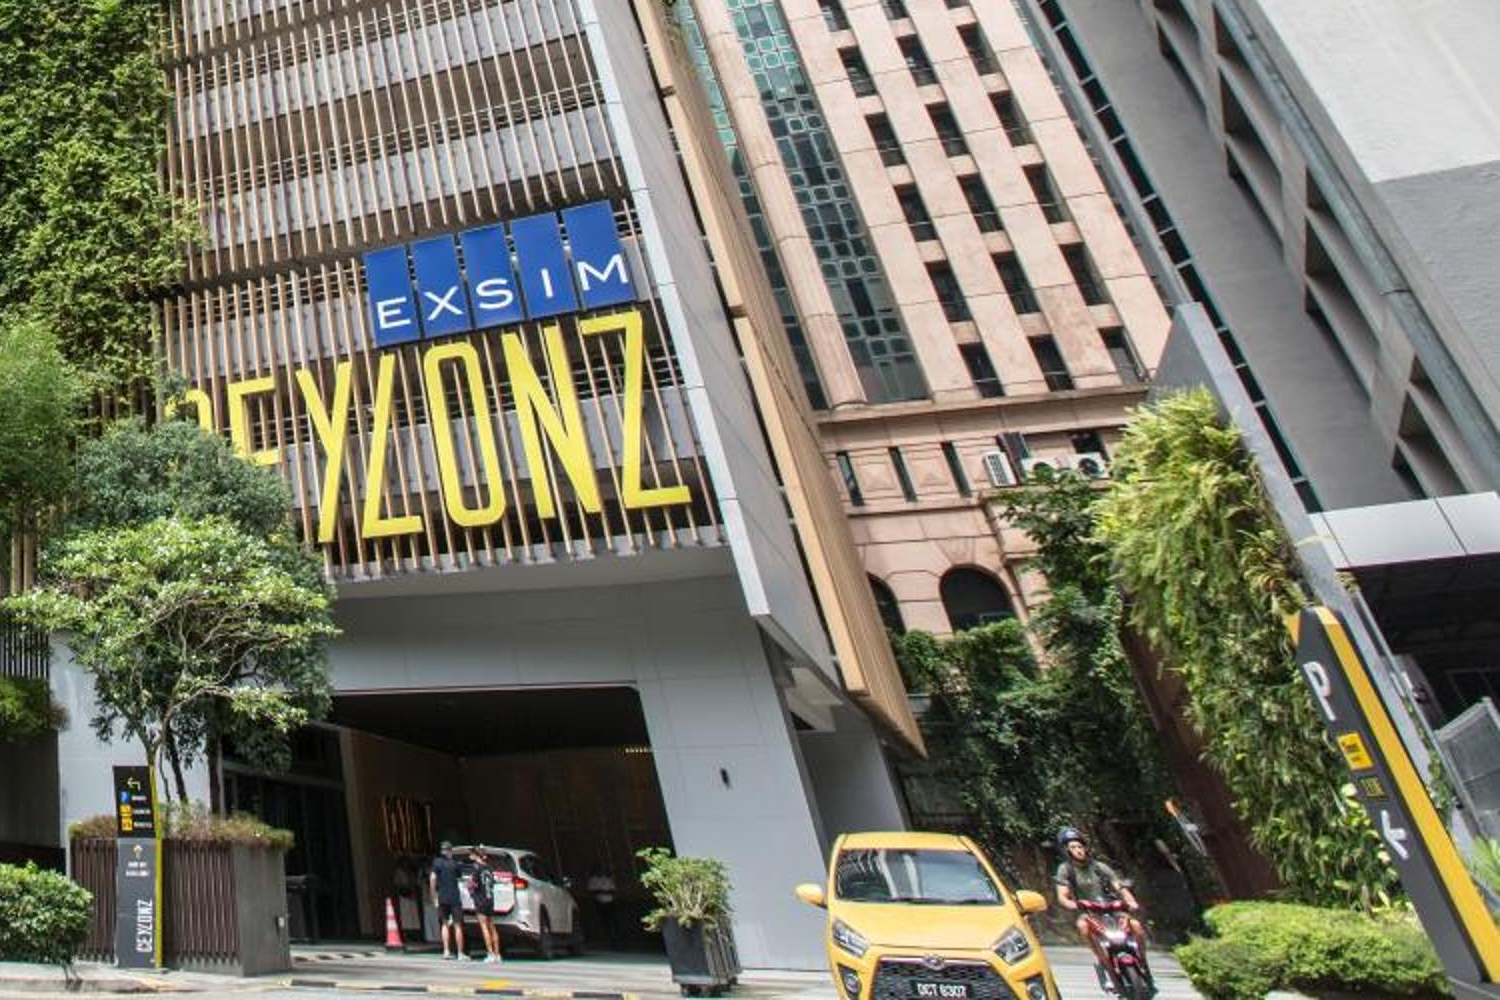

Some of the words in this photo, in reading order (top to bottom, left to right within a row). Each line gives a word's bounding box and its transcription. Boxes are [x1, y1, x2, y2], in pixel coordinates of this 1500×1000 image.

[376, 253, 629, 330] EXSIM
[164, 310, 691, 543] EYLONZ
[1303, 661, 1336, 722] P
[136, 899, 153, 952] CEYLONZ
